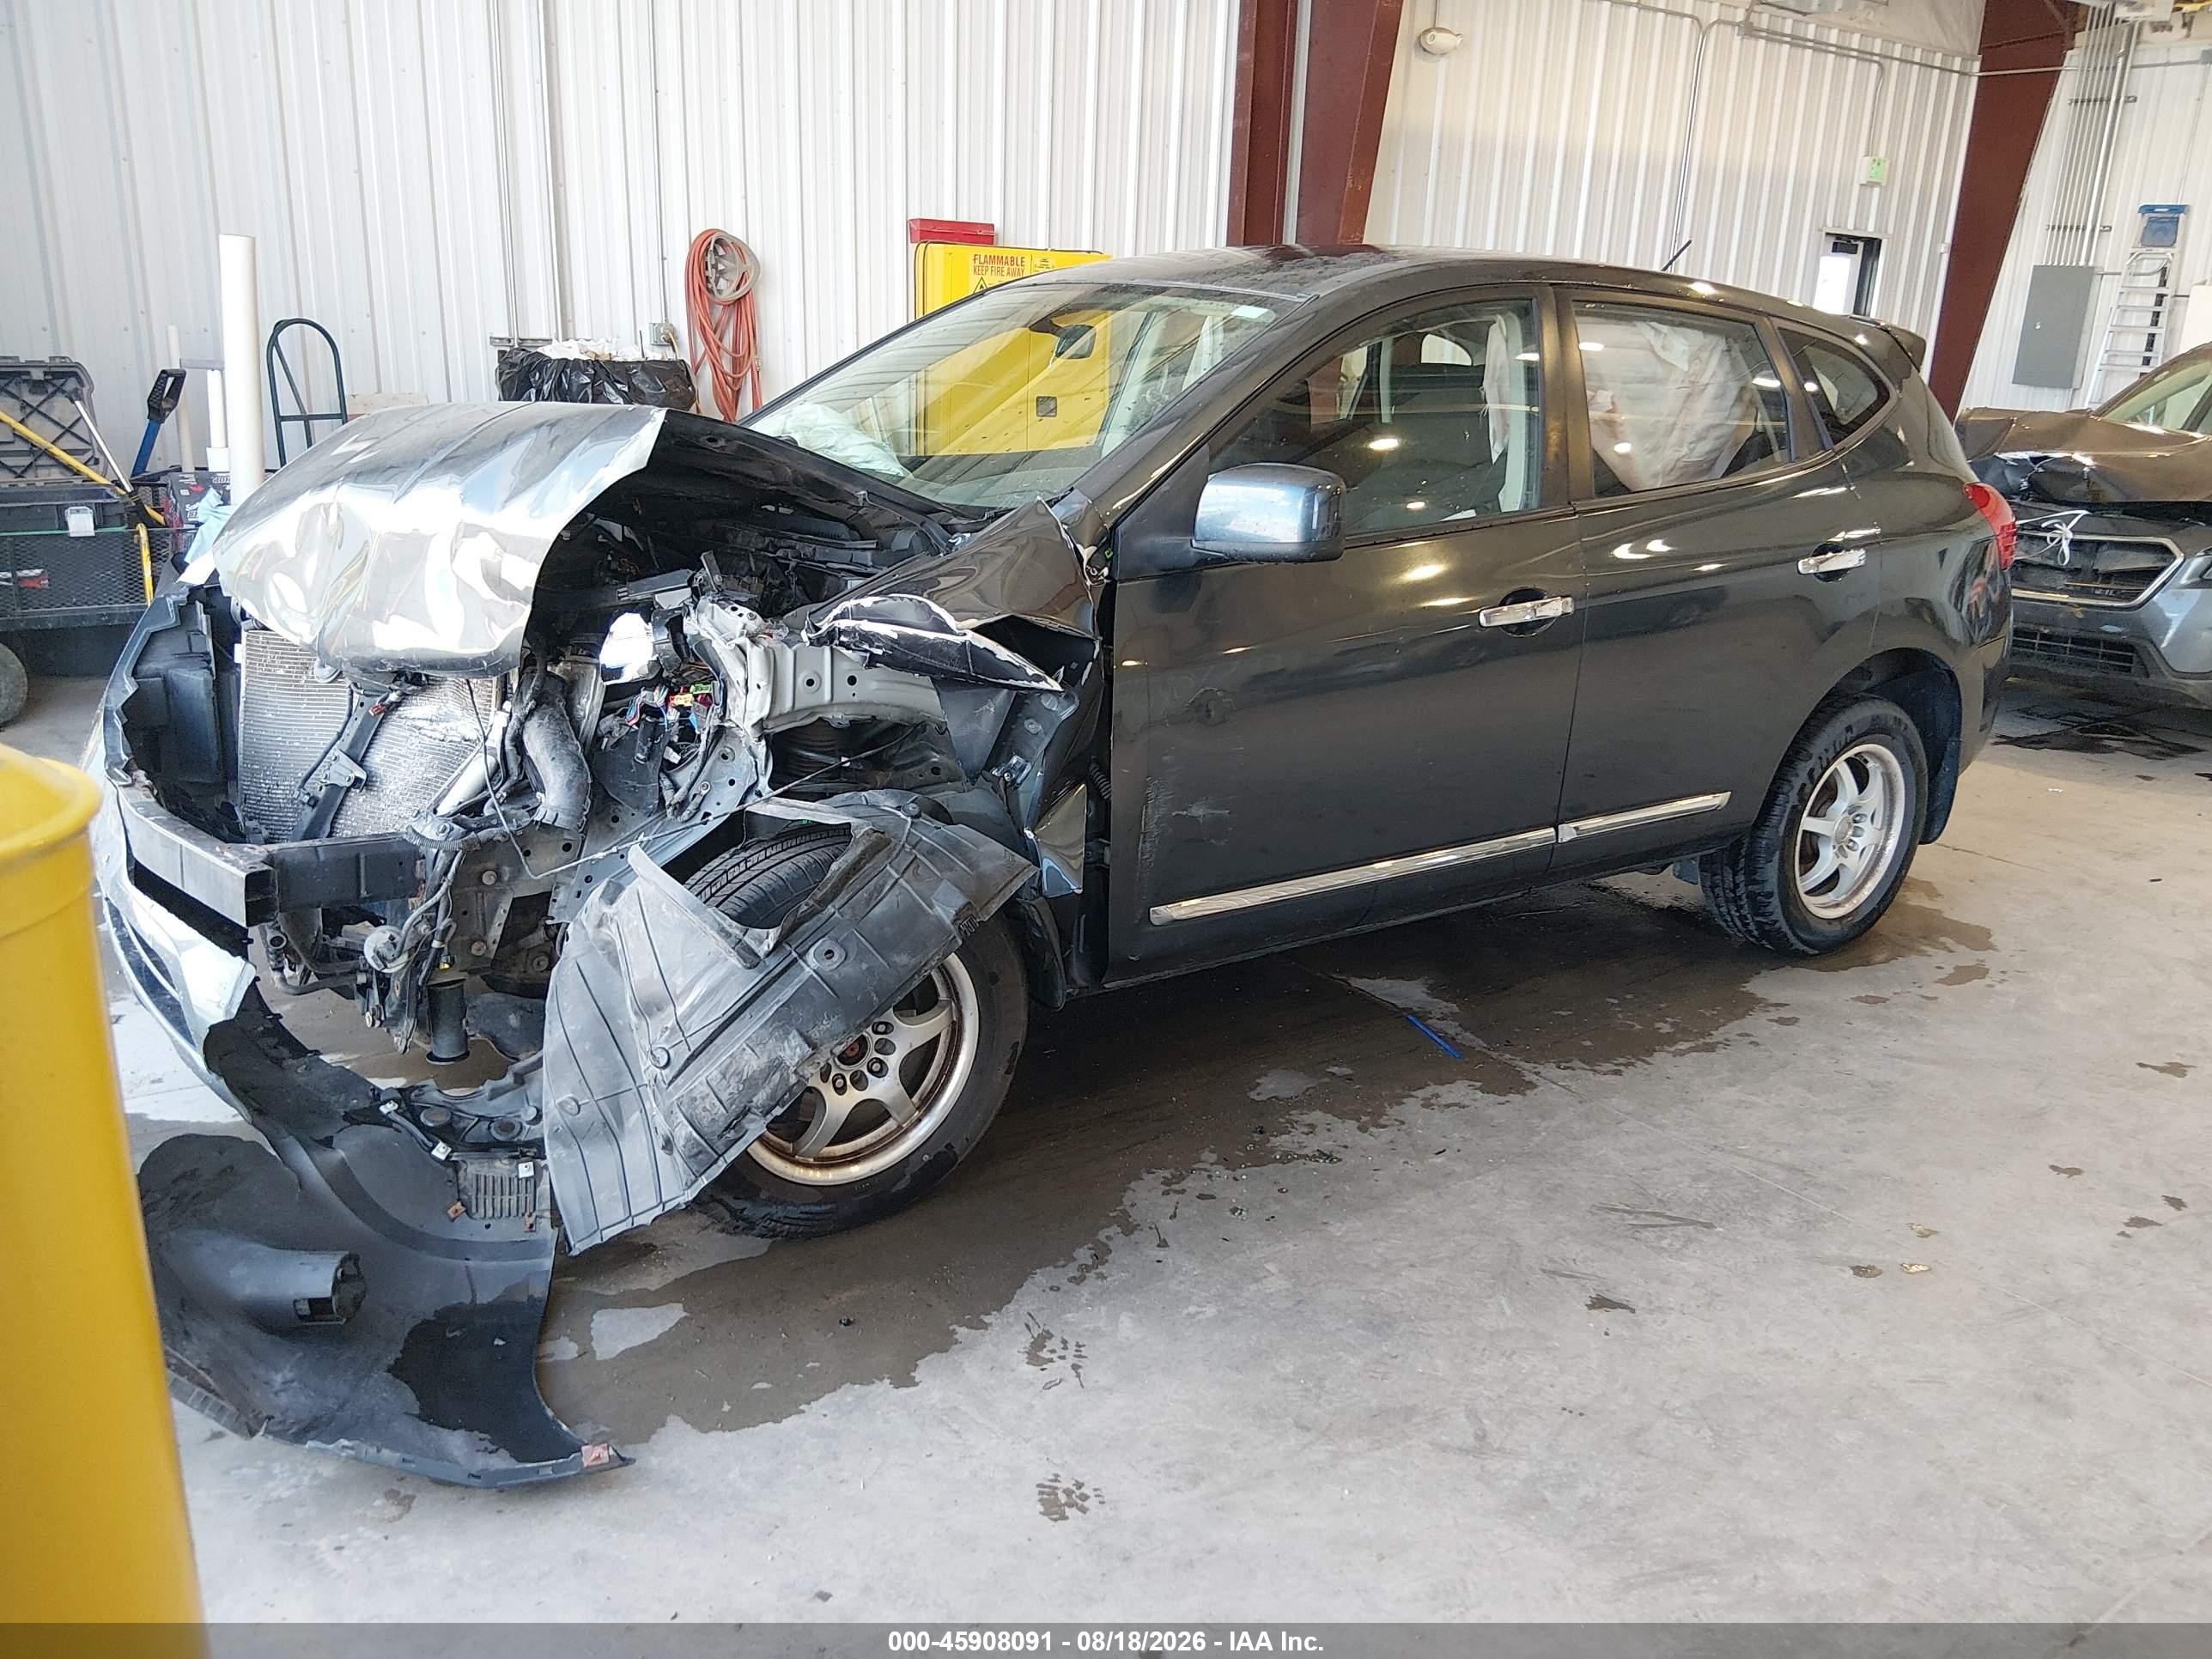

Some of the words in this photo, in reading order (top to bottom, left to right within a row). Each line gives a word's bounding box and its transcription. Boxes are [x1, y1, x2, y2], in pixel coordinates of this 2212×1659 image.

[973, 253, 1025, 267] FLAMMABLE
[973, 265, 989, 276] KEEP
[991, 265, 1005, 276] FIRE
[1006, 267, 1025, 278] AWAY
